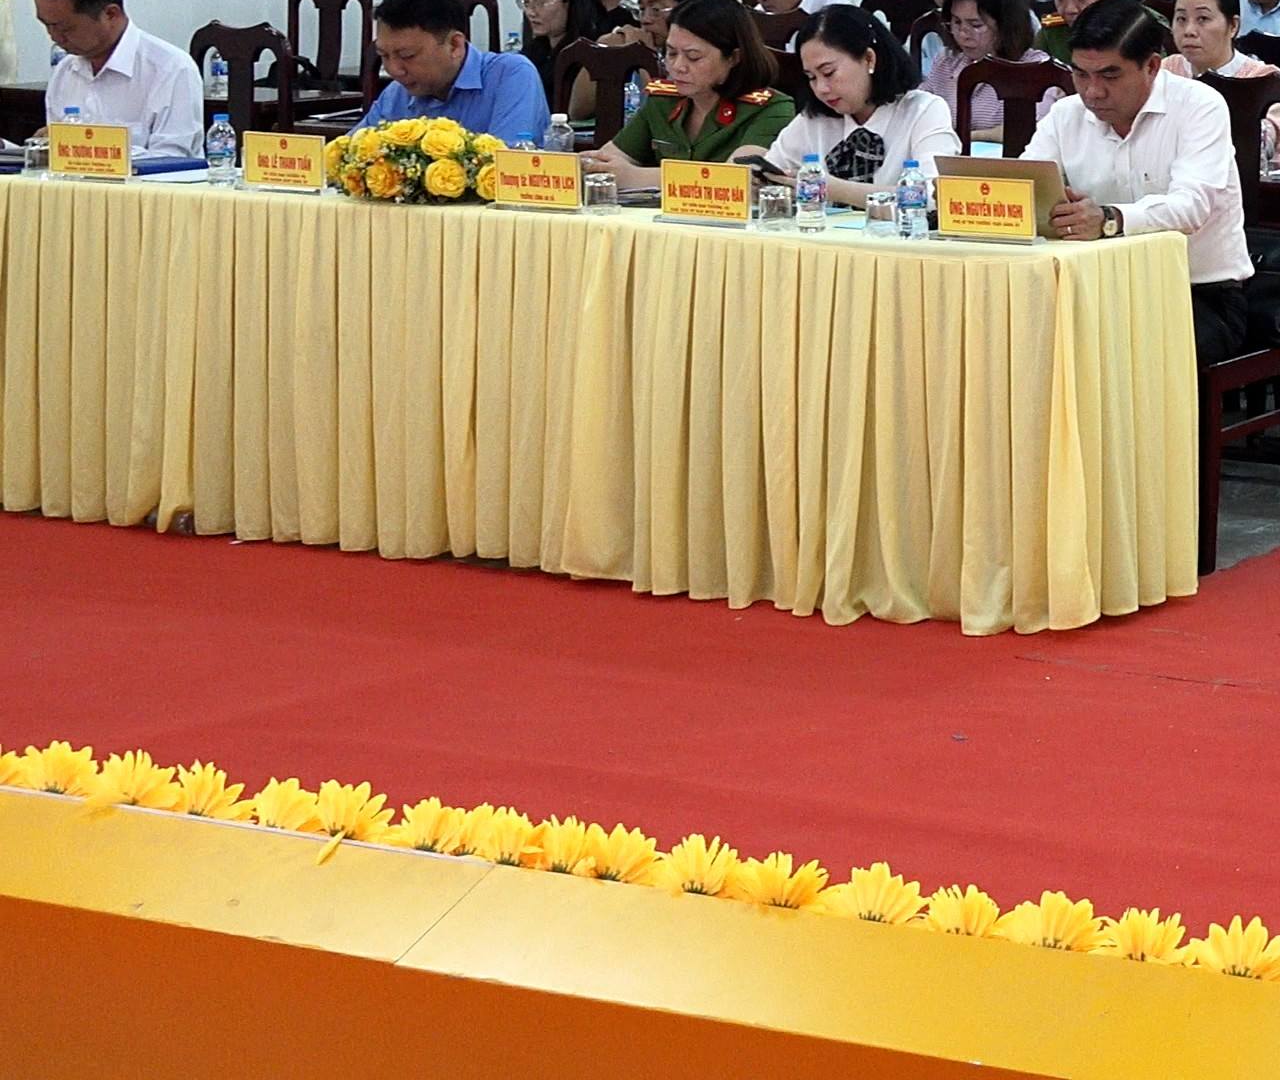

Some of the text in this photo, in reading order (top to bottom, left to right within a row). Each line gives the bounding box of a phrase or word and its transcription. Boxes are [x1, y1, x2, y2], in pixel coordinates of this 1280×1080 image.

[529, 170, 550, 188] NGUYỄN
[679, 181, 702, 199] NGUYỄN
[950, 198, 965, 215] ÔNG:
[966, 198, 992, 217] NGUYỄN
